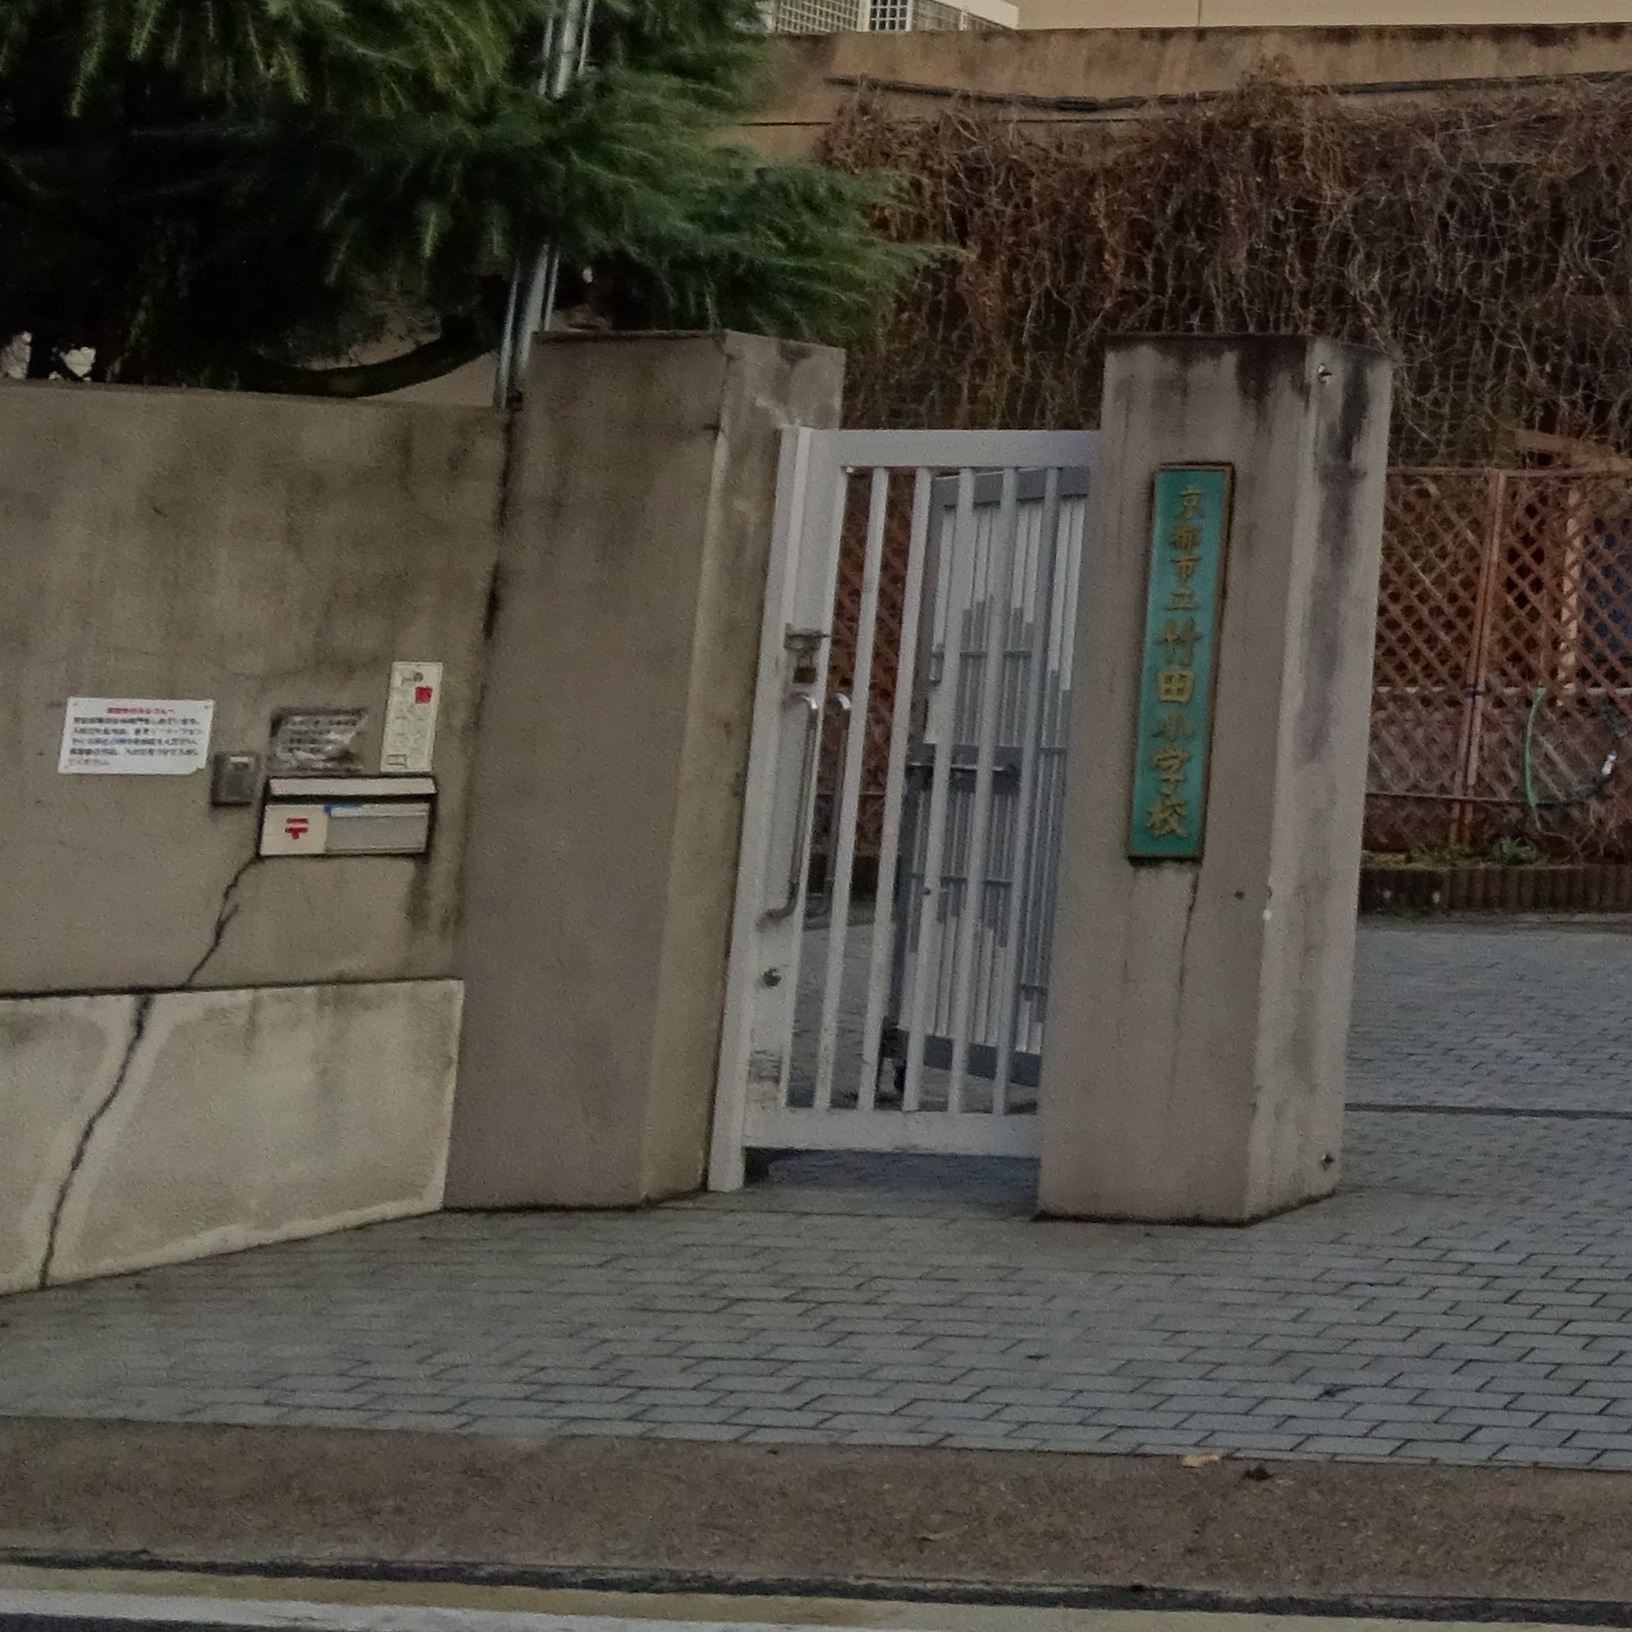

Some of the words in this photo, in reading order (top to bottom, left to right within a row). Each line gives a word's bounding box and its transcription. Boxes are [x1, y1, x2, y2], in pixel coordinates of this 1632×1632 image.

[1146, 485, 1204, 837] 京都市立竹田小学校
